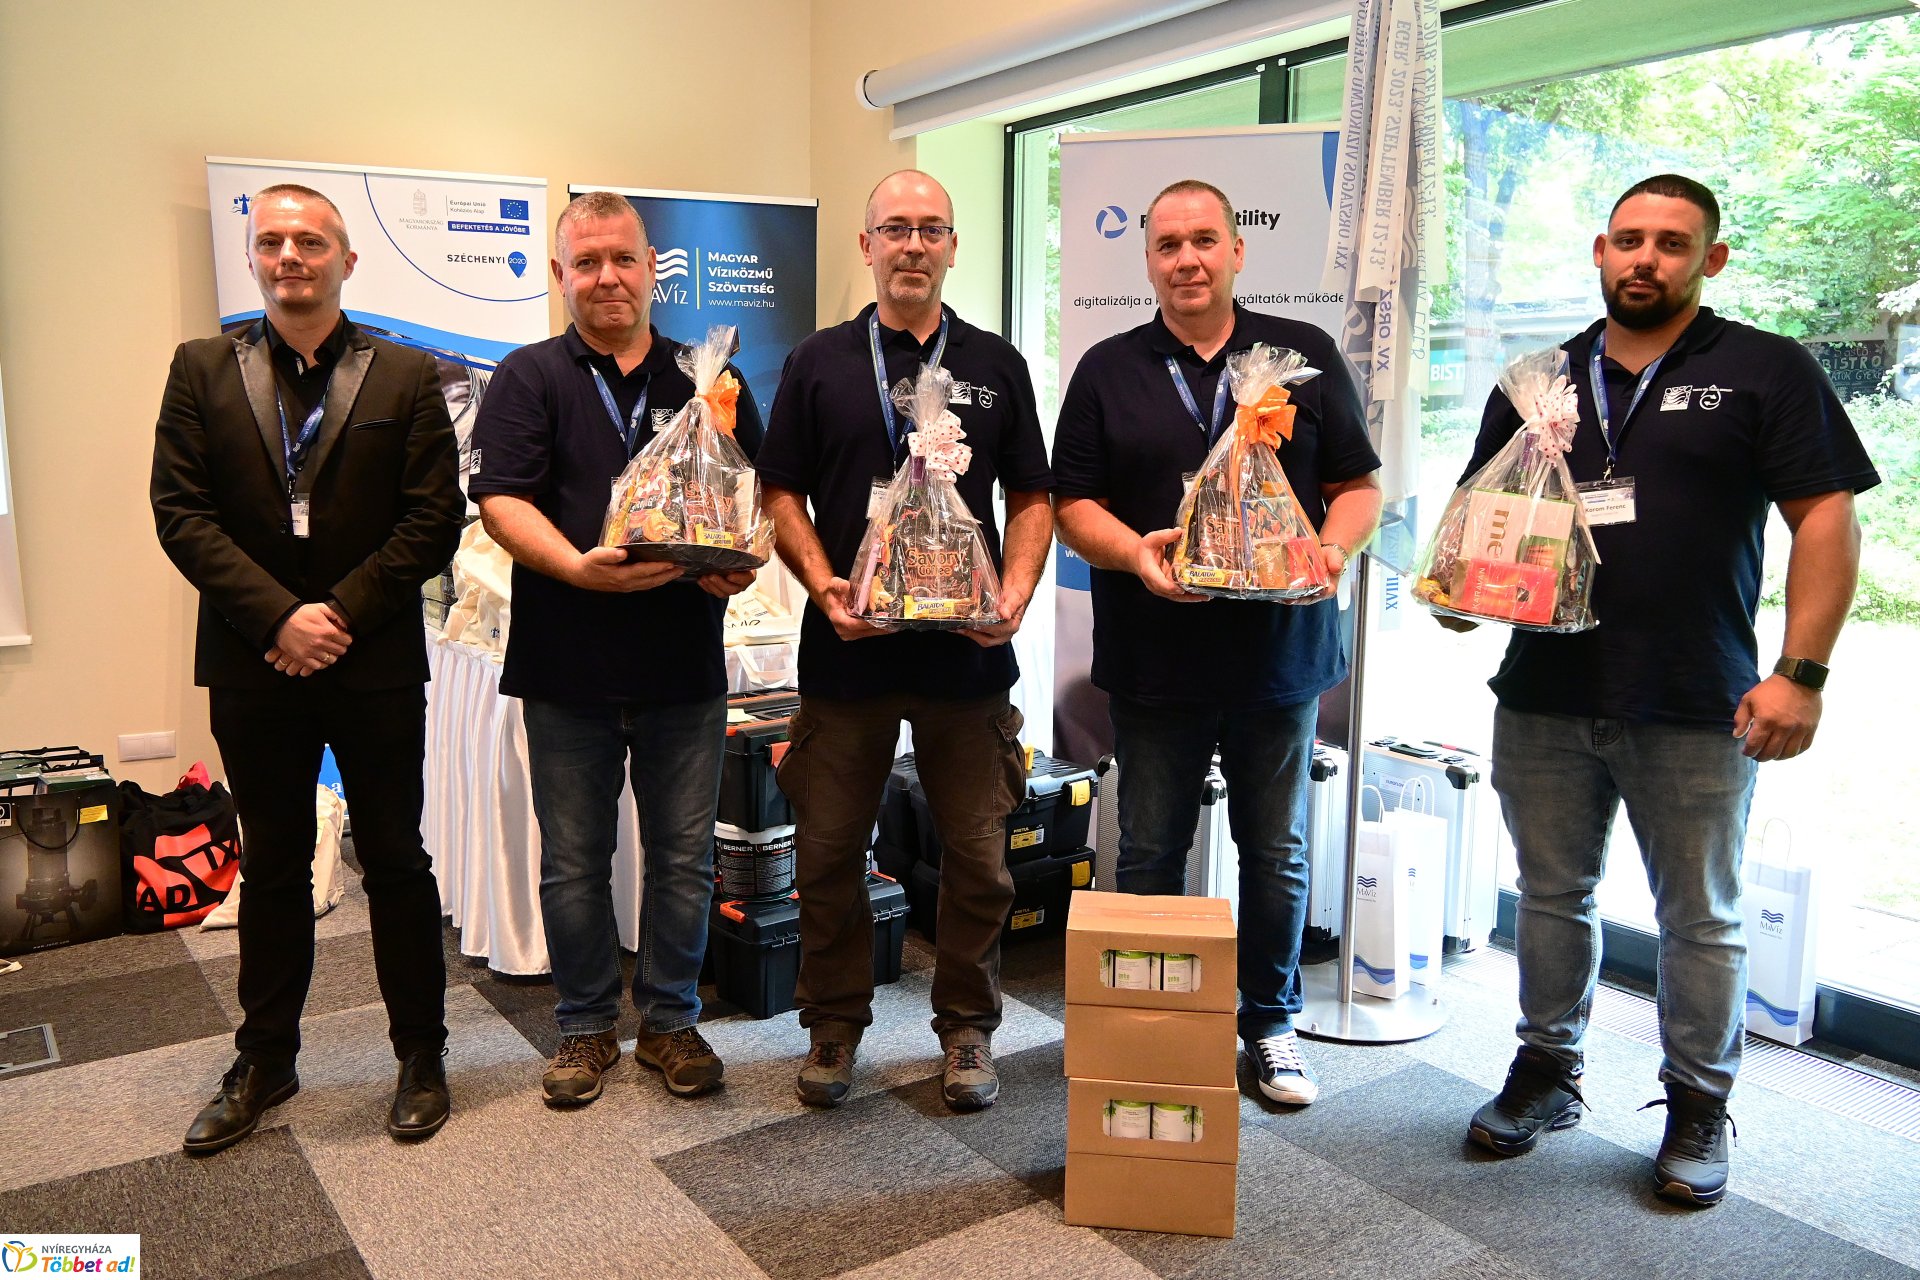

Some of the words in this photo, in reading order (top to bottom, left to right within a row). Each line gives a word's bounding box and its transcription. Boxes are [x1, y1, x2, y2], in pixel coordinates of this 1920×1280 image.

[1236, 209, 1281, 230] tility
[451, 222, 494, 232] BEFEKTETÉS
[447, 253, 506, 264] SZÉCHENYI
[508, 257, 528, 265] 2020
[708, 298, 775, 308] www.maviz.hu
[1074, 295, 1141, 309] digitalizálja
[1235, 292, 1291, 306] lgáltatók
[906, 548, 965, 568] Savory
[917, 565, 951, 576] Coffee
[723, 843, 753, 852] BERNER
[762, 840, 792, 852] BERNER
